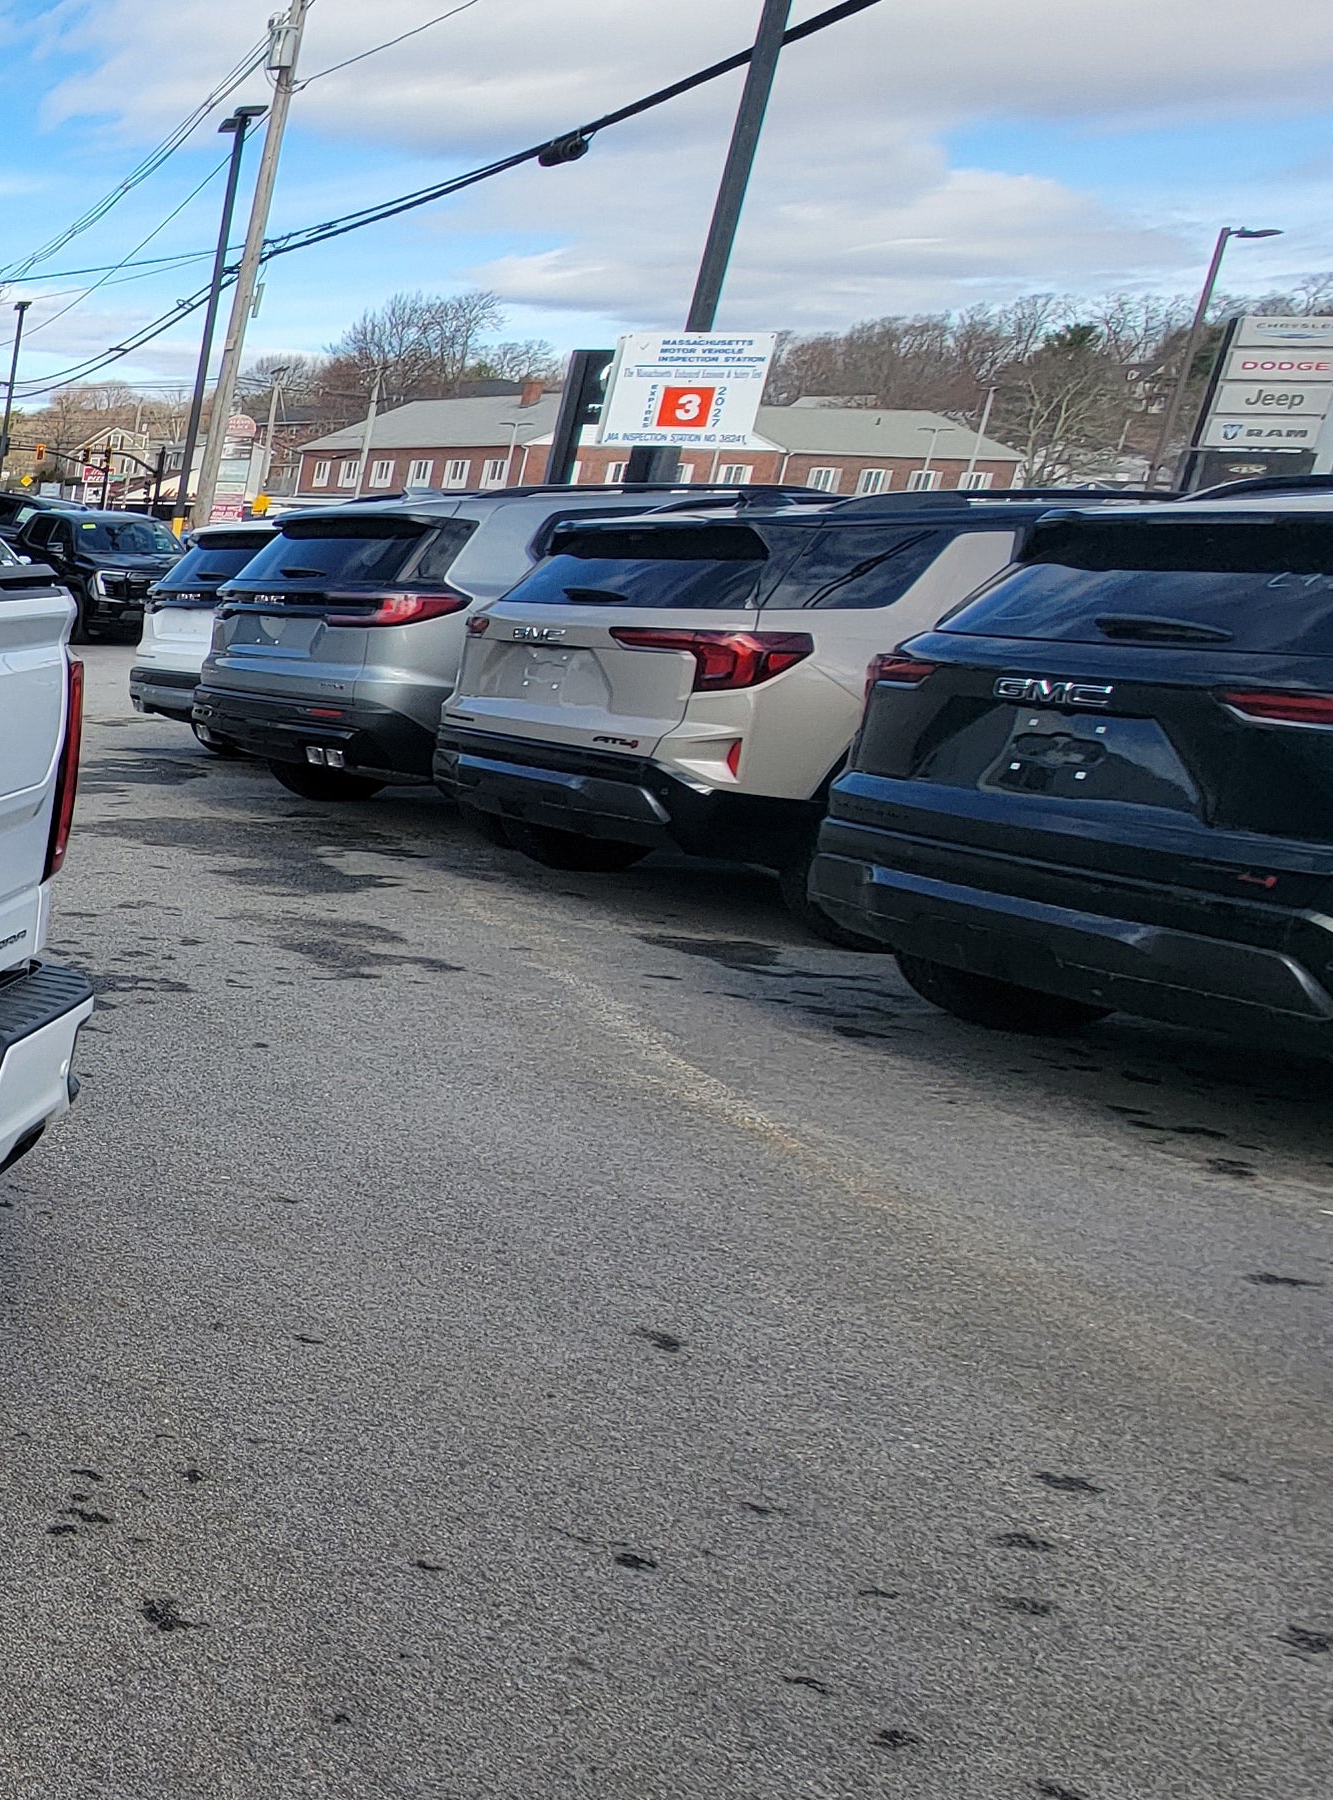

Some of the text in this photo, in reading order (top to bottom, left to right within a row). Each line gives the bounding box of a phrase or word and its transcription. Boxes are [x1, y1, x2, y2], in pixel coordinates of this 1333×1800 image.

[1256, 322, 1333, 330] CHRYSLE
[1241, 361, 1332, 371] DODGE
[674, 393, 702, 421] 3
[711, 386, 728, 428] 2027
[1245, 389, 1305, 410] Jeep
[621, 432, 667, 442] INSPECTION
[670, 433, 701, 443] STATION
[1244, 428, 1309, 438] RAM
[513, 626, 567, 642] GMC
[993, 677, 1114, 708] GMC
